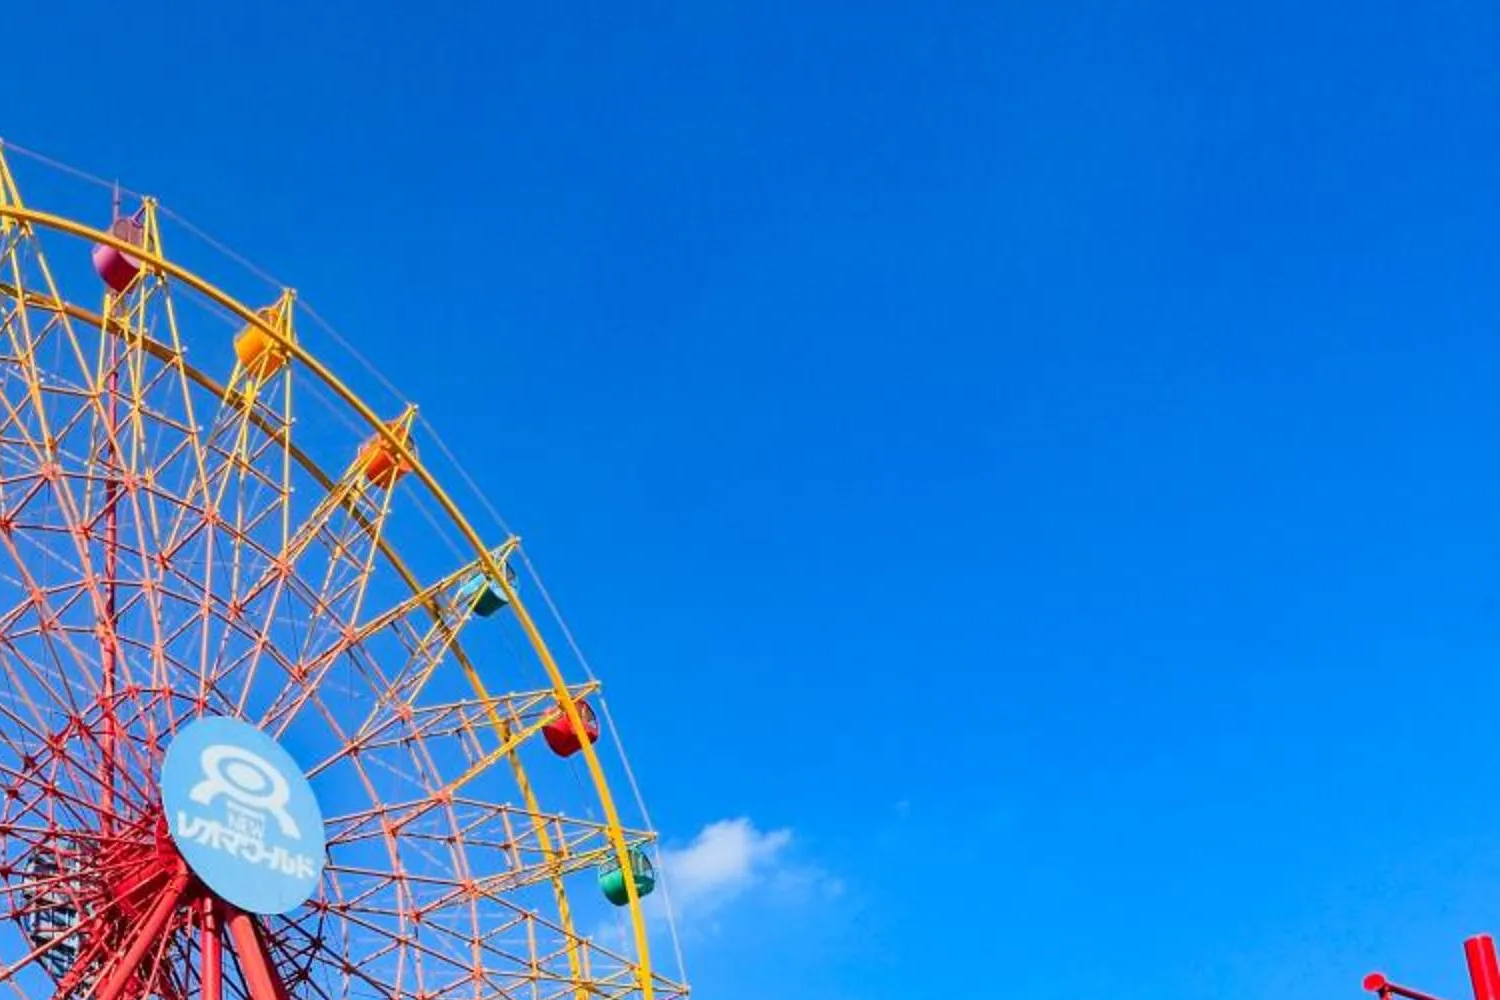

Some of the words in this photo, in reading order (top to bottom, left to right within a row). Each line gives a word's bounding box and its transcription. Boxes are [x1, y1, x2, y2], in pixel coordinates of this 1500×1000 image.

[177, 811, 315, 878] レオマワールド
